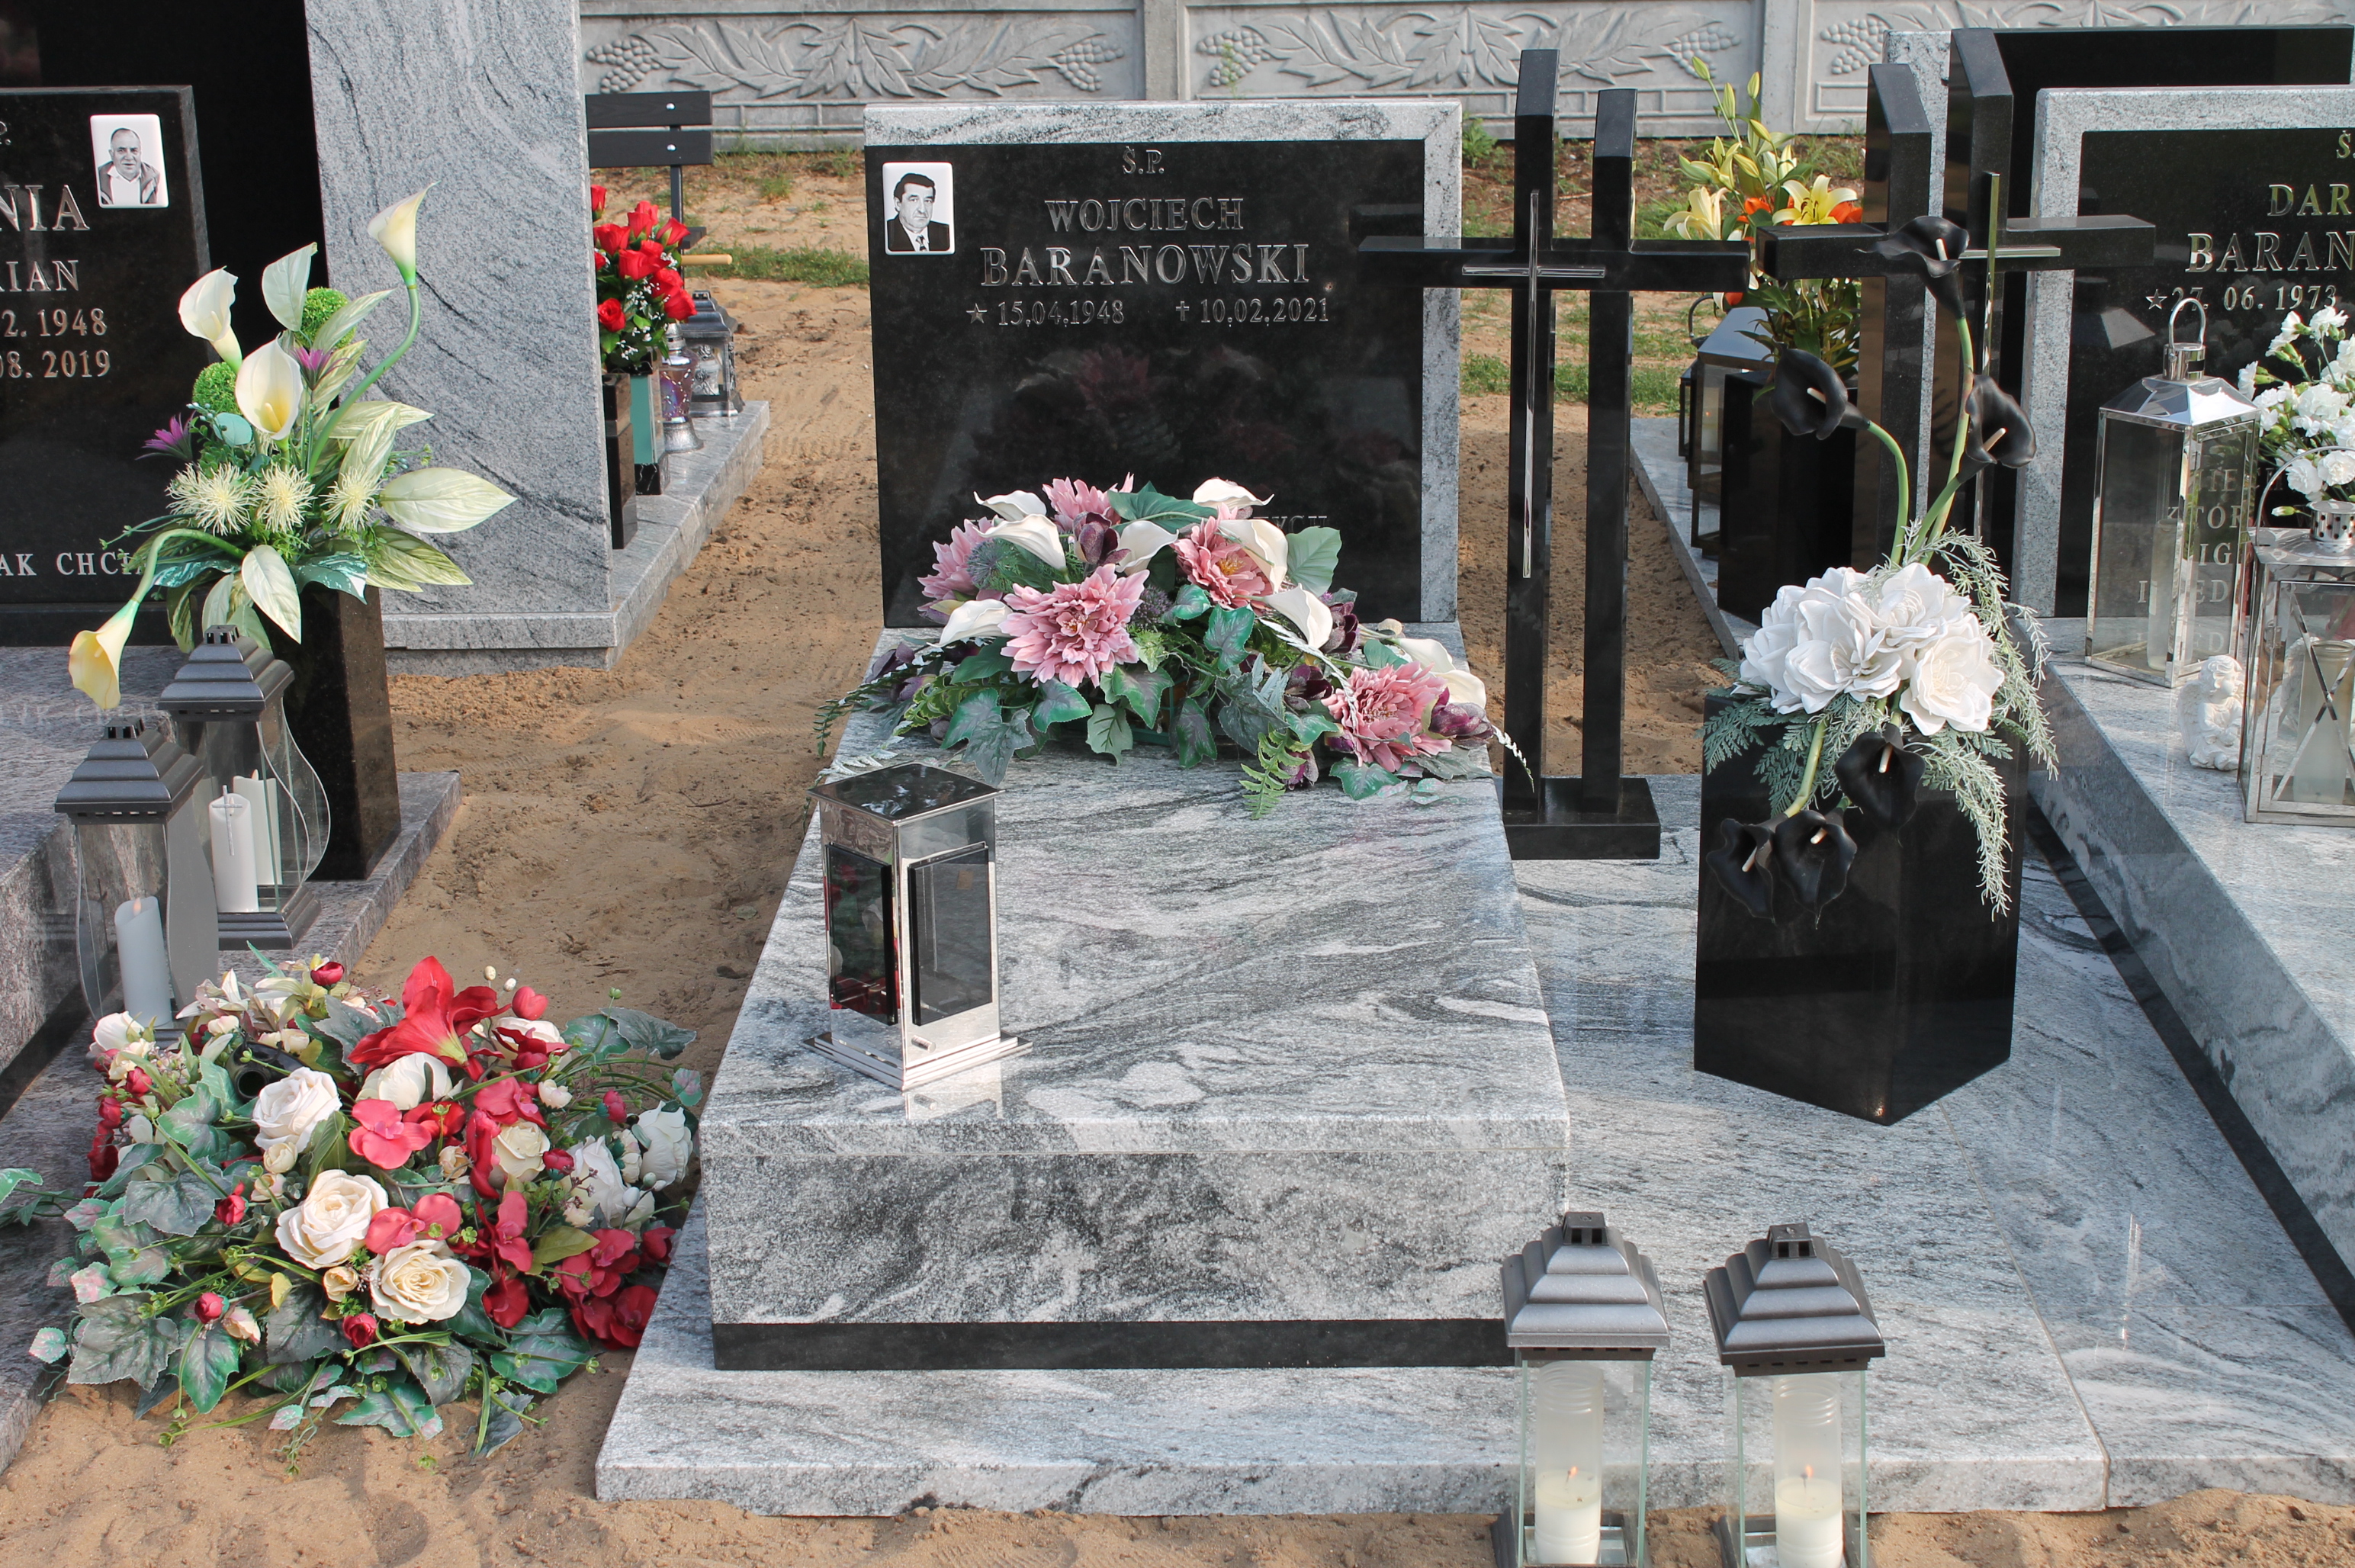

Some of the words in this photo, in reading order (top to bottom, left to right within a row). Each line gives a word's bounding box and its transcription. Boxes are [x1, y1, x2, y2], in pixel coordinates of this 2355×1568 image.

[1044, 198, 1245, 232] WOJCIECH
[0, 259, 79, 292] IAN
[980, 243, 1309, 286] BARANOWSKI
[37, 307, 108, 336] 1948
[41, 349, 111, 378] 2019
[56, 551, 146, 576] CHCI
